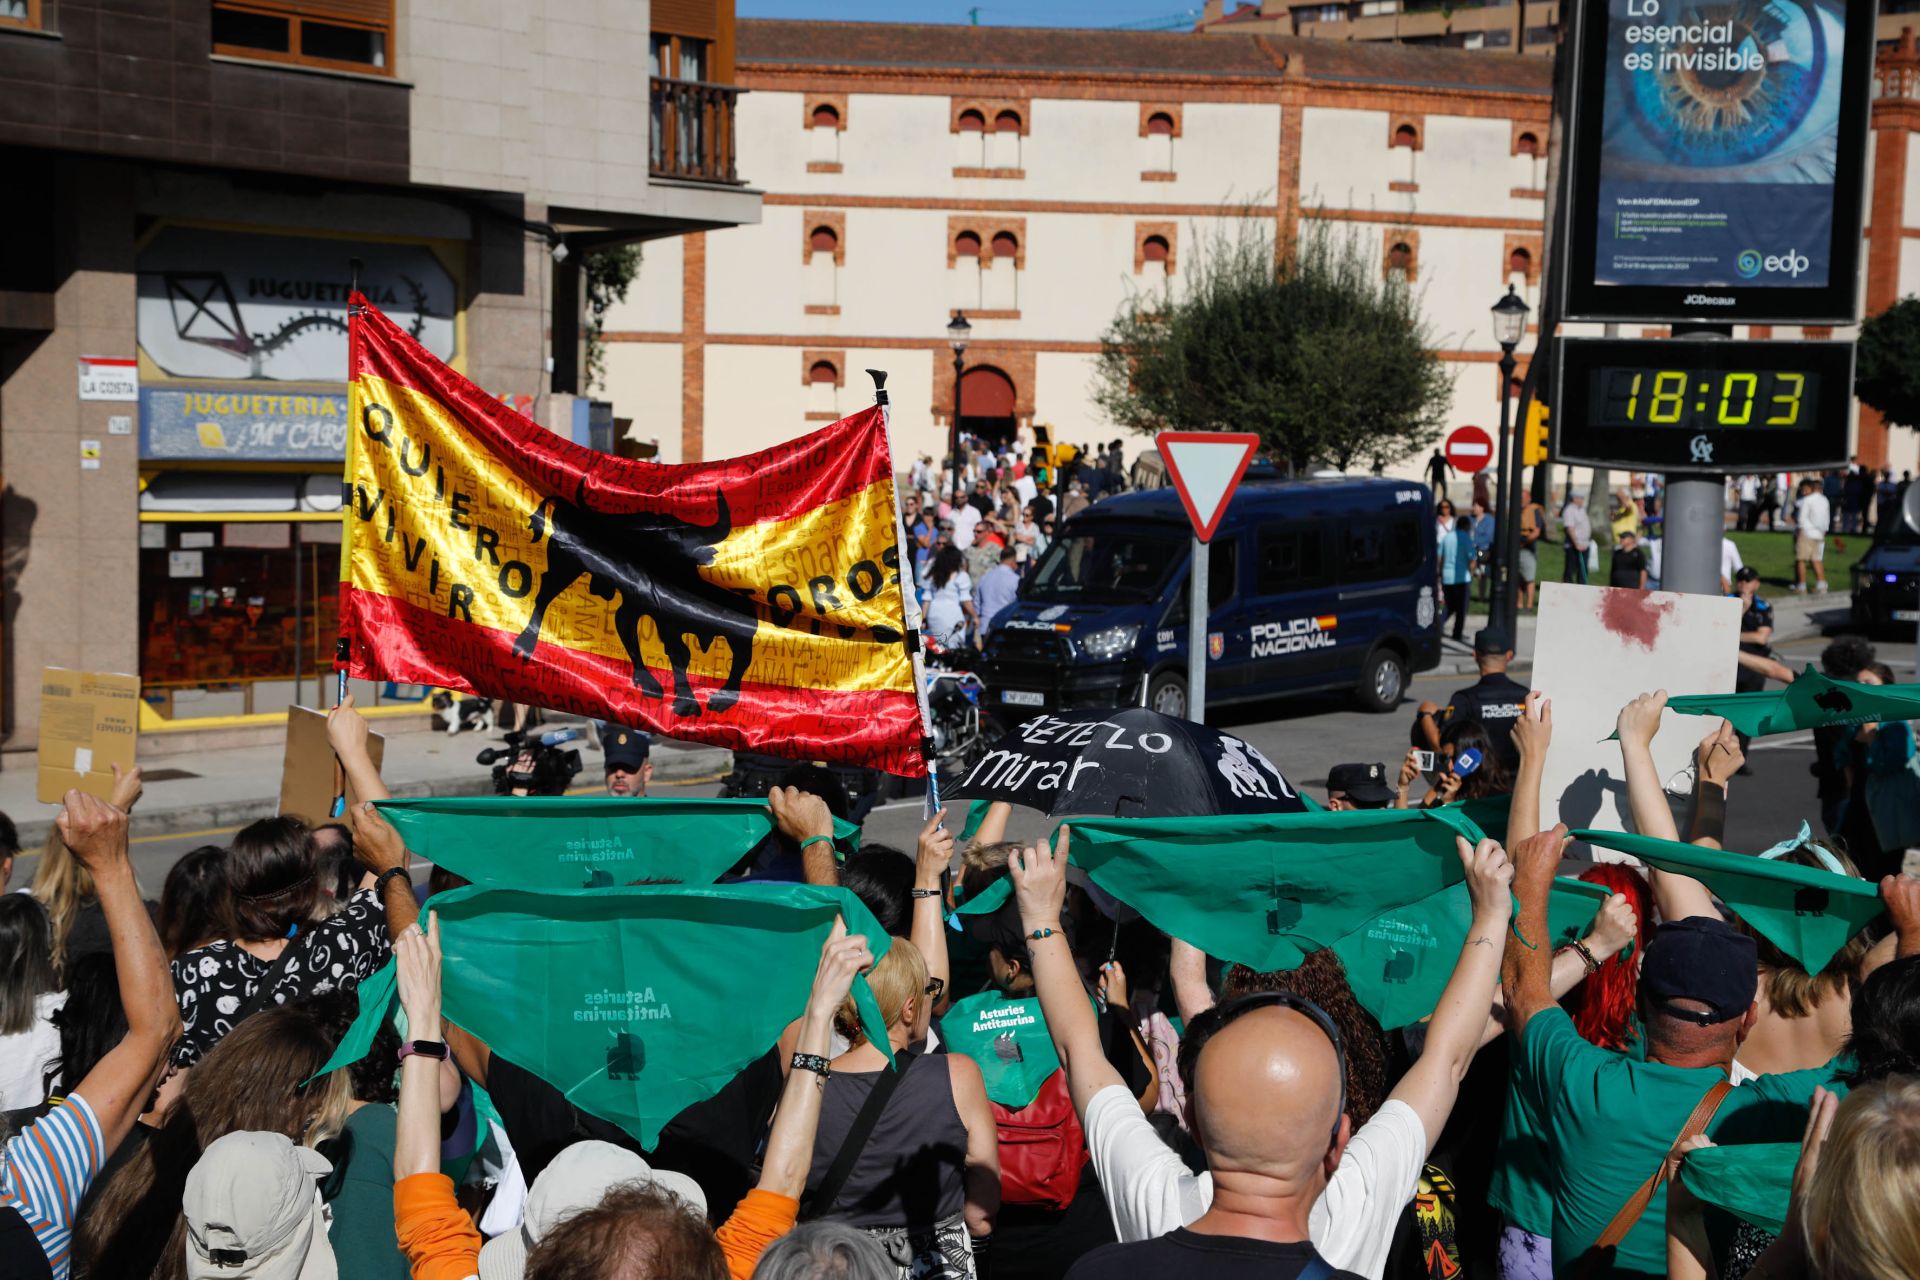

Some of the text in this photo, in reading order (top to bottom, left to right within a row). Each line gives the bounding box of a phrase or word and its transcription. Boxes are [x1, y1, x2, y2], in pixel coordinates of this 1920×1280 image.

[1627, 0, 1659, 17] Lo
[1625, 20, 1733, 44] esencial
[1623, 47, 1764, 71] es invisible
[1764, 248, 1810, 278] edp
[1683, 295, 1736, 305] JCDecaux
[82, 381, 136, 395] LA COSTA
[1626, 371, 1805, 425] 18:03
[184, 392, 338, 417] JUGUETERIA
[1005, 619, 1056, 632] POLICIA
[1250, 616, 1321, 641] POLICIA
[1251, 631, 1337, 658] NACIONAL
[1482, 703, 1519, 711] POLICIA
[980, 1005, 1025, 1020] Asturies
[973, 1015, 1035, 1033] Antitaurina
